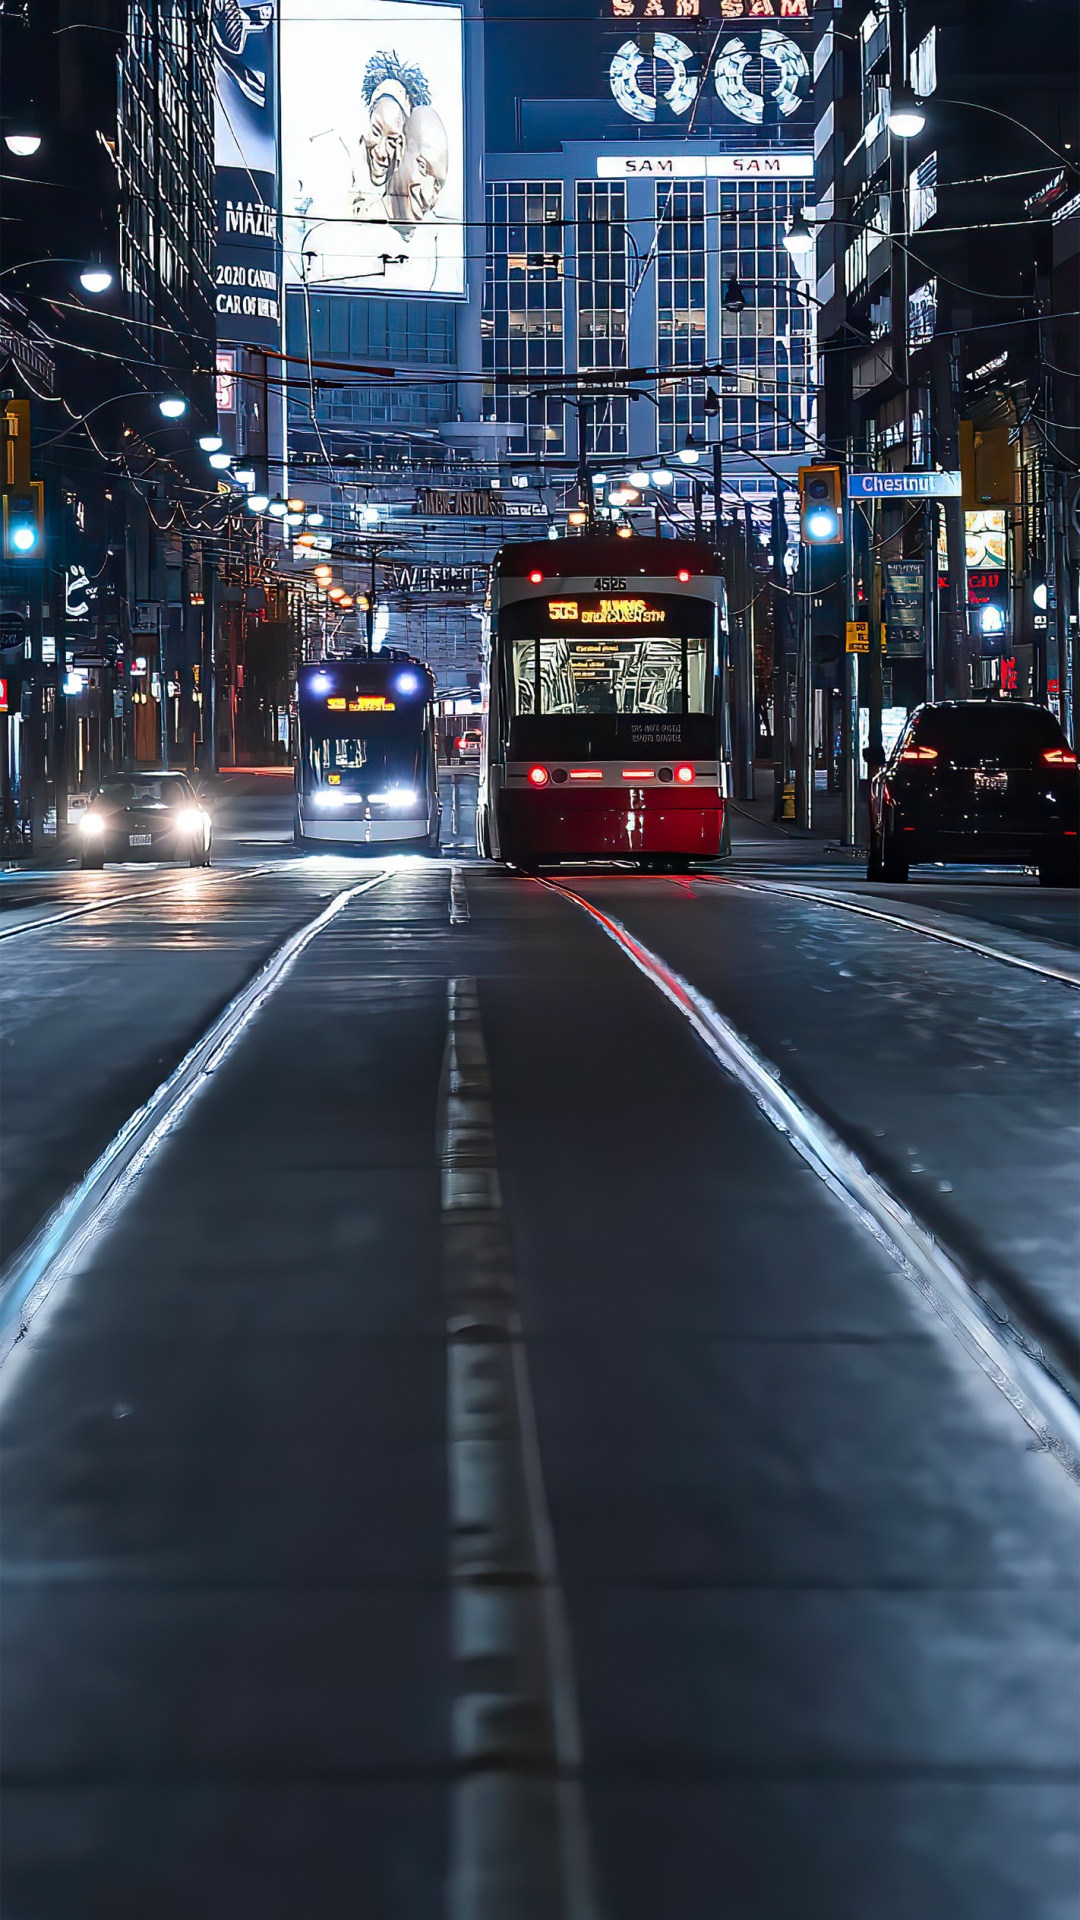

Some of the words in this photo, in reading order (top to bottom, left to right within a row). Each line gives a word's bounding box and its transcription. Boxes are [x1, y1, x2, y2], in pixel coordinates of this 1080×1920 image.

[612, 0, 699, 16] SAM
[720, 0, 809, 16] SAM
[625, 160, 673, 172] SAM
[732, 159, 781, 171] SAM
[216, 264, 246, 286] 2020
[216, 293, 241, 314] CAR
[548, 601, 579, 620] 505
